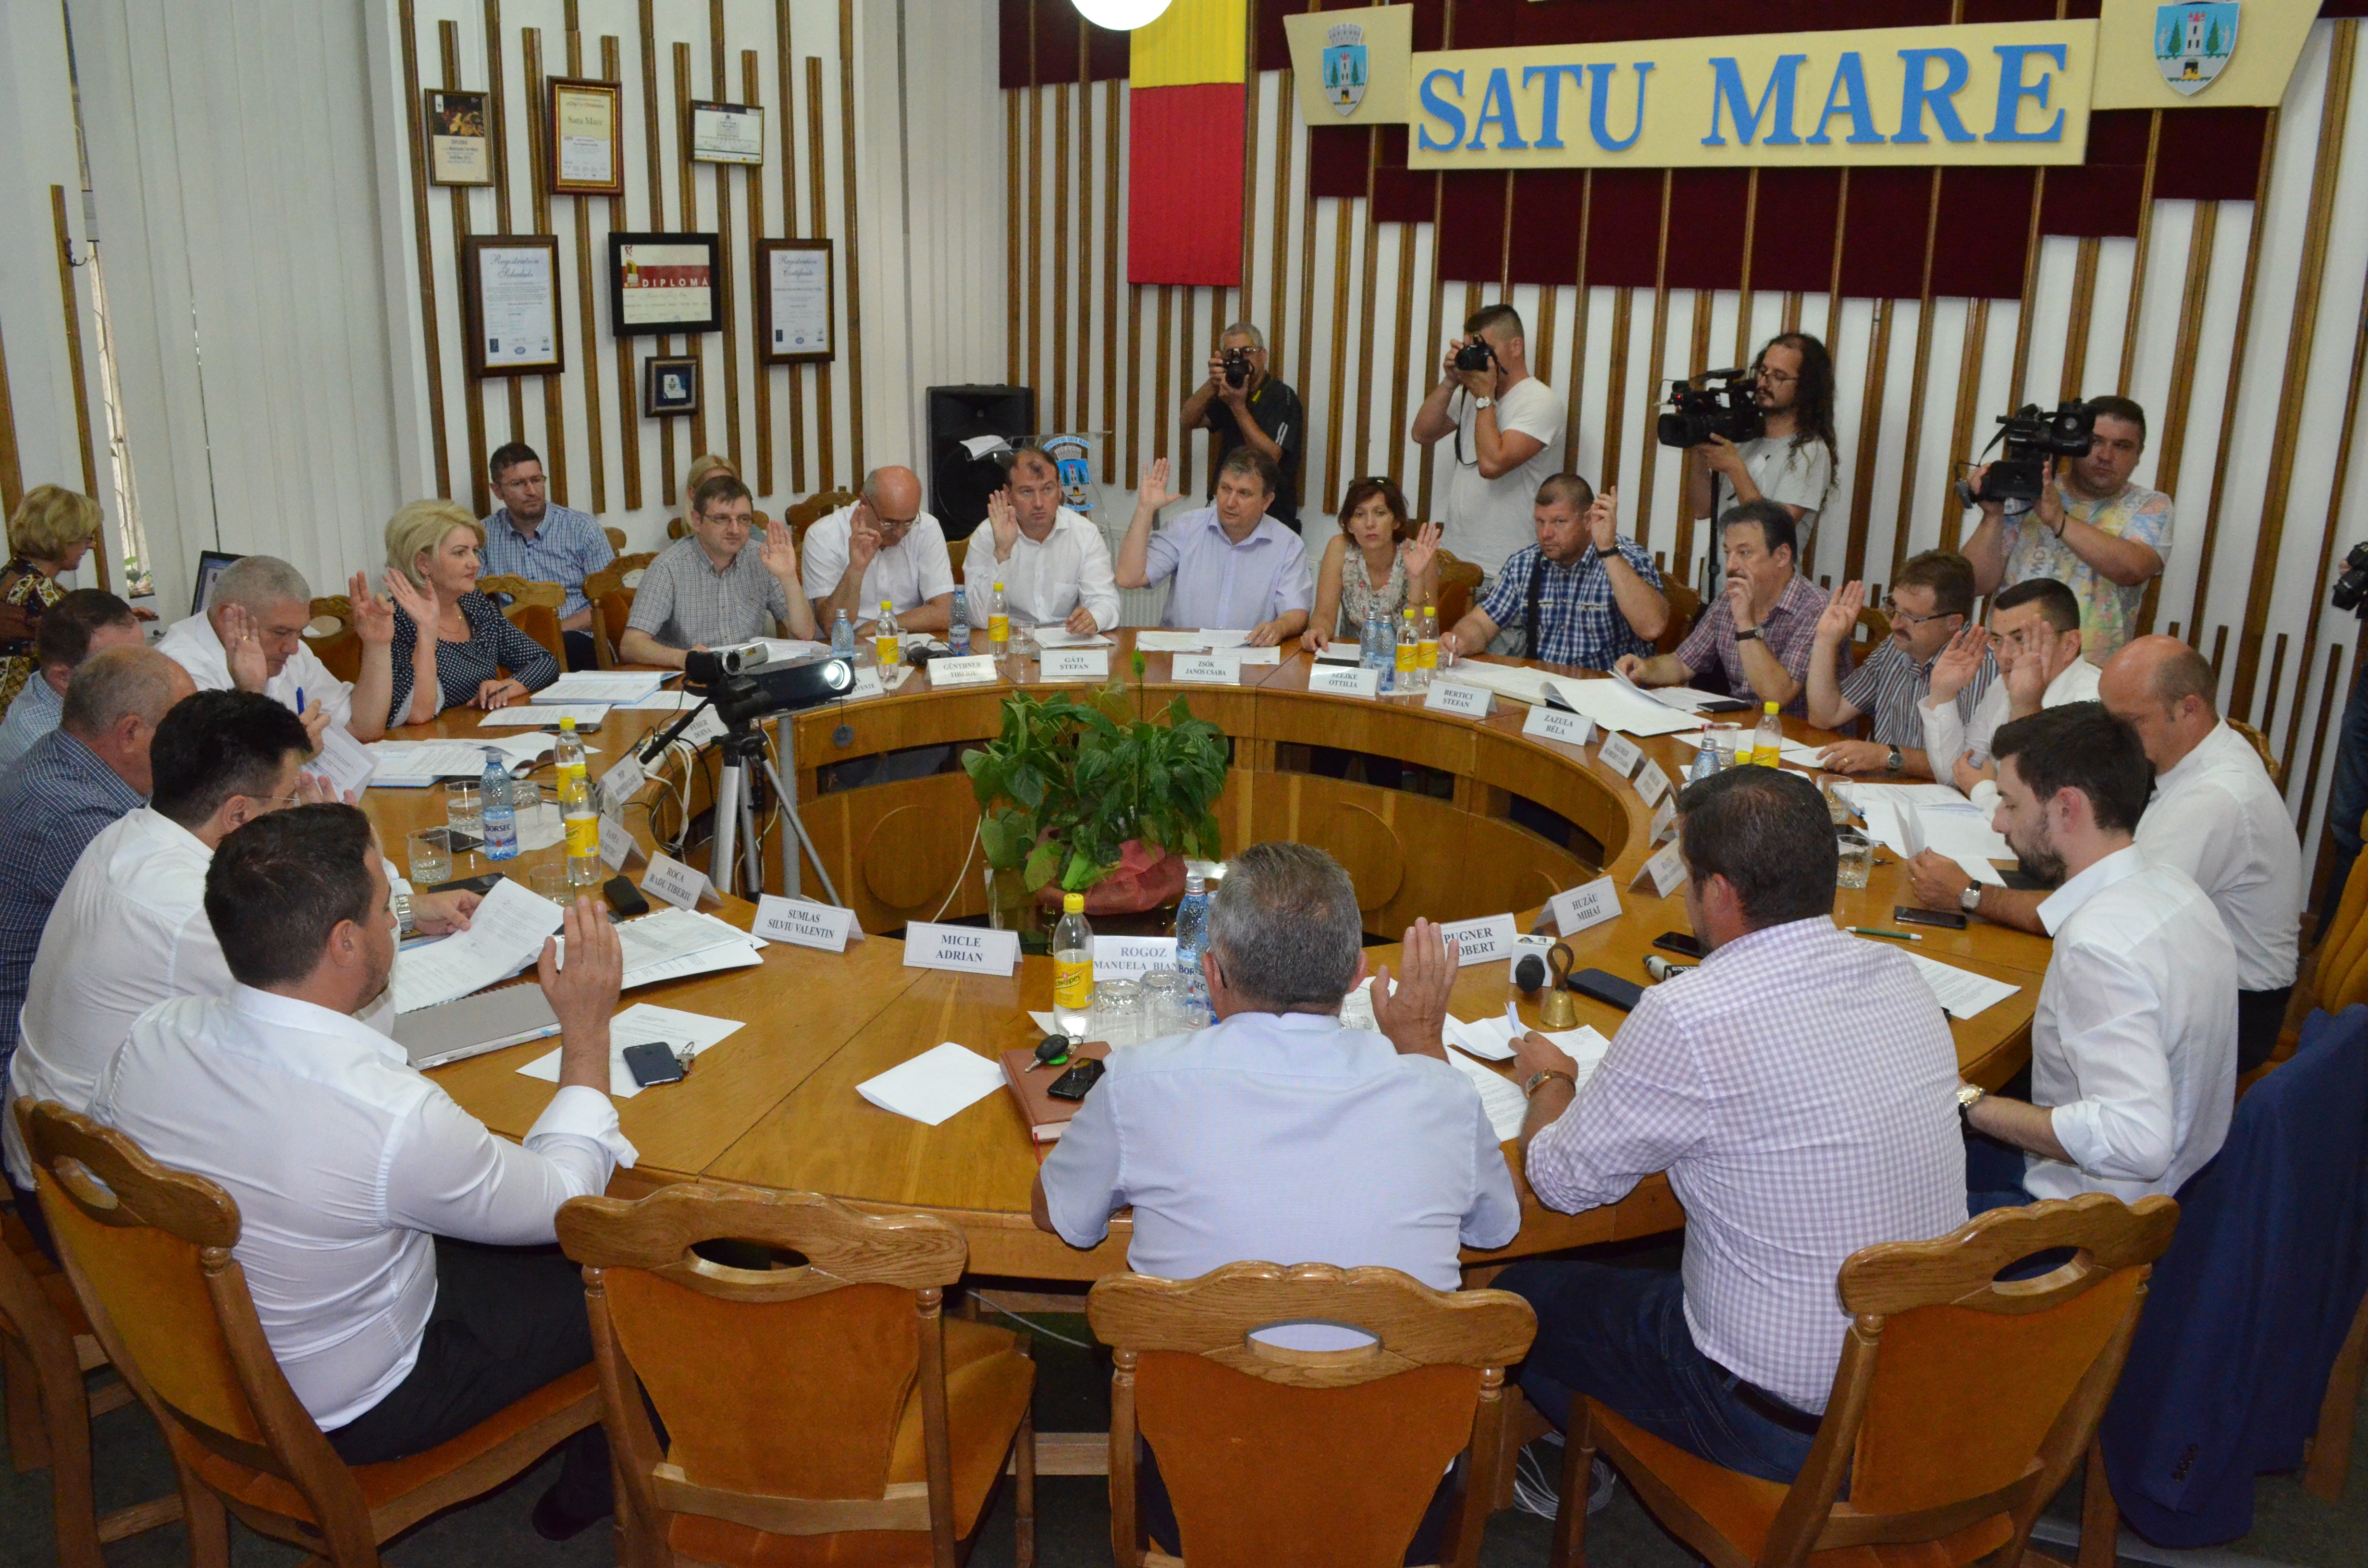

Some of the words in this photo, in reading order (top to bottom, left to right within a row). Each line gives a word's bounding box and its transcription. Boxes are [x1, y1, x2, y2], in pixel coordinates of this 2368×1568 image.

[1418, 62, 1654, 152] SATU
[1701, 44, 2067, 145] MARE
[568, 115, 583, 124] Satu
[854, 683, 876, 691] EVENTE
[1444, 689, 1474, 700] BERTICI
[1544, 714, 1573, 727] ZAZULA
[1546, 724, 1565, 735] BÉLA
[485, 823, 511, 832] BORSEC
[666, 867, 684, 883] ROCA
[649, 873, 667, 888] RADU
[667, 882, 693, 901] TIBERIU
[1572, 893, 1598, 910] HUZĂU
[788, 909, 820, 923] SUMLAS
[1577, 906, 1601, 921] MIHAI
[767, 919, 794, 931] SILVIU
[795, 924, 835, 939] VALENTIN
[1443, 927, 1493, 944] PUGNER
[941, 934, 981, 947] MICLE
[1121, 947, 1167, 957] ROGOZ
[1458, 941, 1495, 957] OBERT
[935, 950, 983, 962] ADRIAN
[1093, 961, 1147, 970] MANUELA
